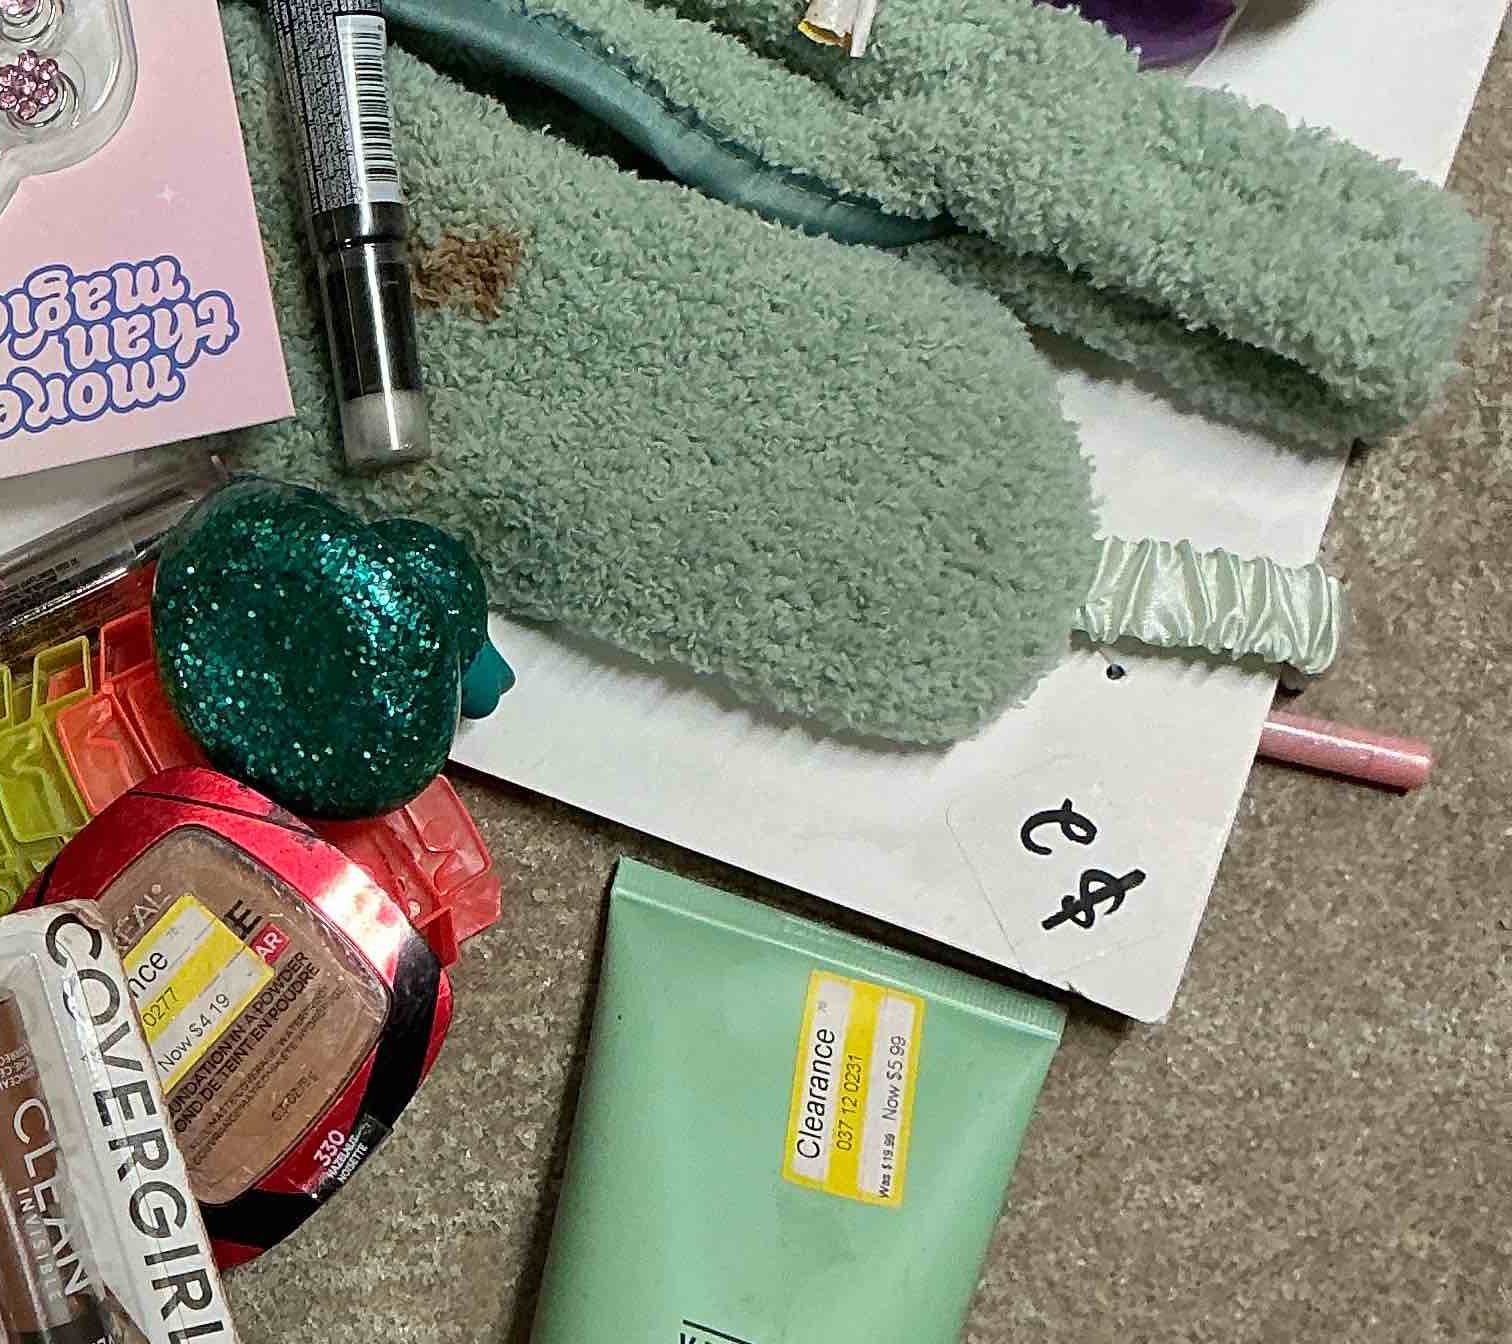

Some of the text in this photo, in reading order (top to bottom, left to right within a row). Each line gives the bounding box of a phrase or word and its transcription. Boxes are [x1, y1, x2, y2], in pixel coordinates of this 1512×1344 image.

[30, 290, 239, 373] than
[1020, 798, 1147, 931] $2
[139, 985, 178, 1028] 0277
[198, 963, 321, 1101] DE TEINT EN POUDRE
[226, 951, 310, 1043] IN A POWDER
[156, 1035, 192, 1072] Now
[795, 1028, 835, 1159] Clearance
[833, 1053, 863, 1151] 037 12 0231
[881, 1083, 900, 1120] Now
[308, 1126, 350, 1168] 330
[878, 1173, 892, 1199] Was
[879, 1132, 897, 1170] $19.99
[14, 1097, 88, 1297] CLEAN
[17, 1189, 69, 1304] INVISIBLE
